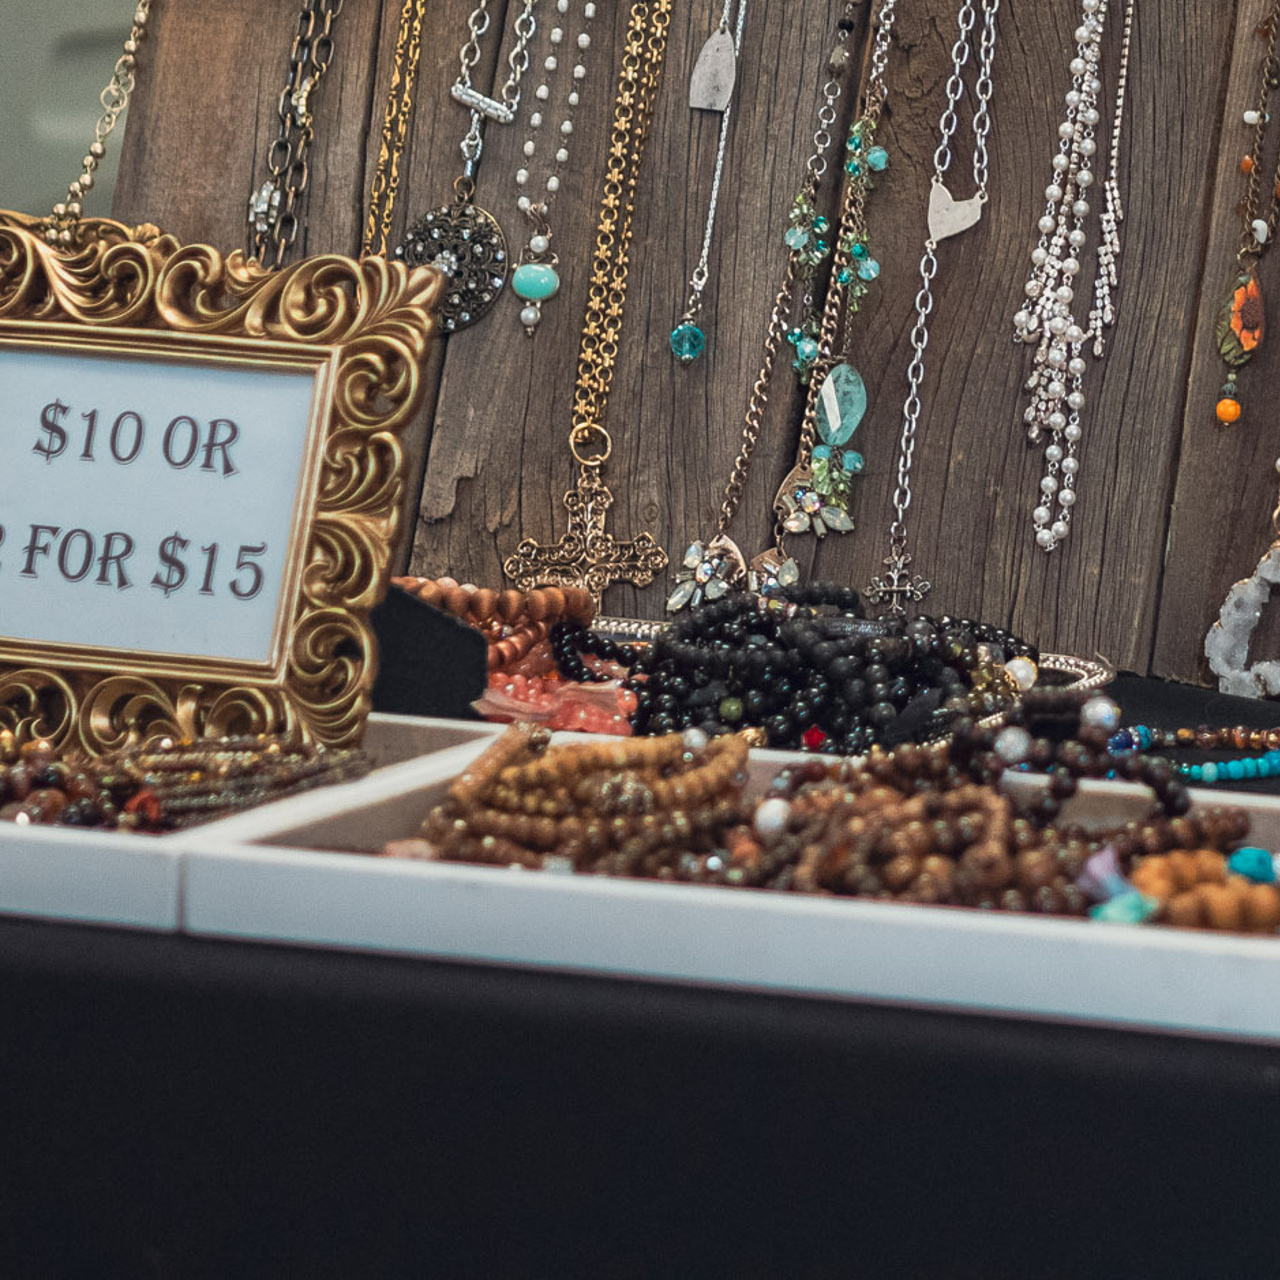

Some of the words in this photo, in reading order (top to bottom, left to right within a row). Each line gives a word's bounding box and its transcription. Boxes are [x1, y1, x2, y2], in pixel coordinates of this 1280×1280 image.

[33, 398, 144, 465] $10
[162, 415, 240, 477] OR
[20, 524, 135, 590] FOR
[151, 531, 268, 600] $15
